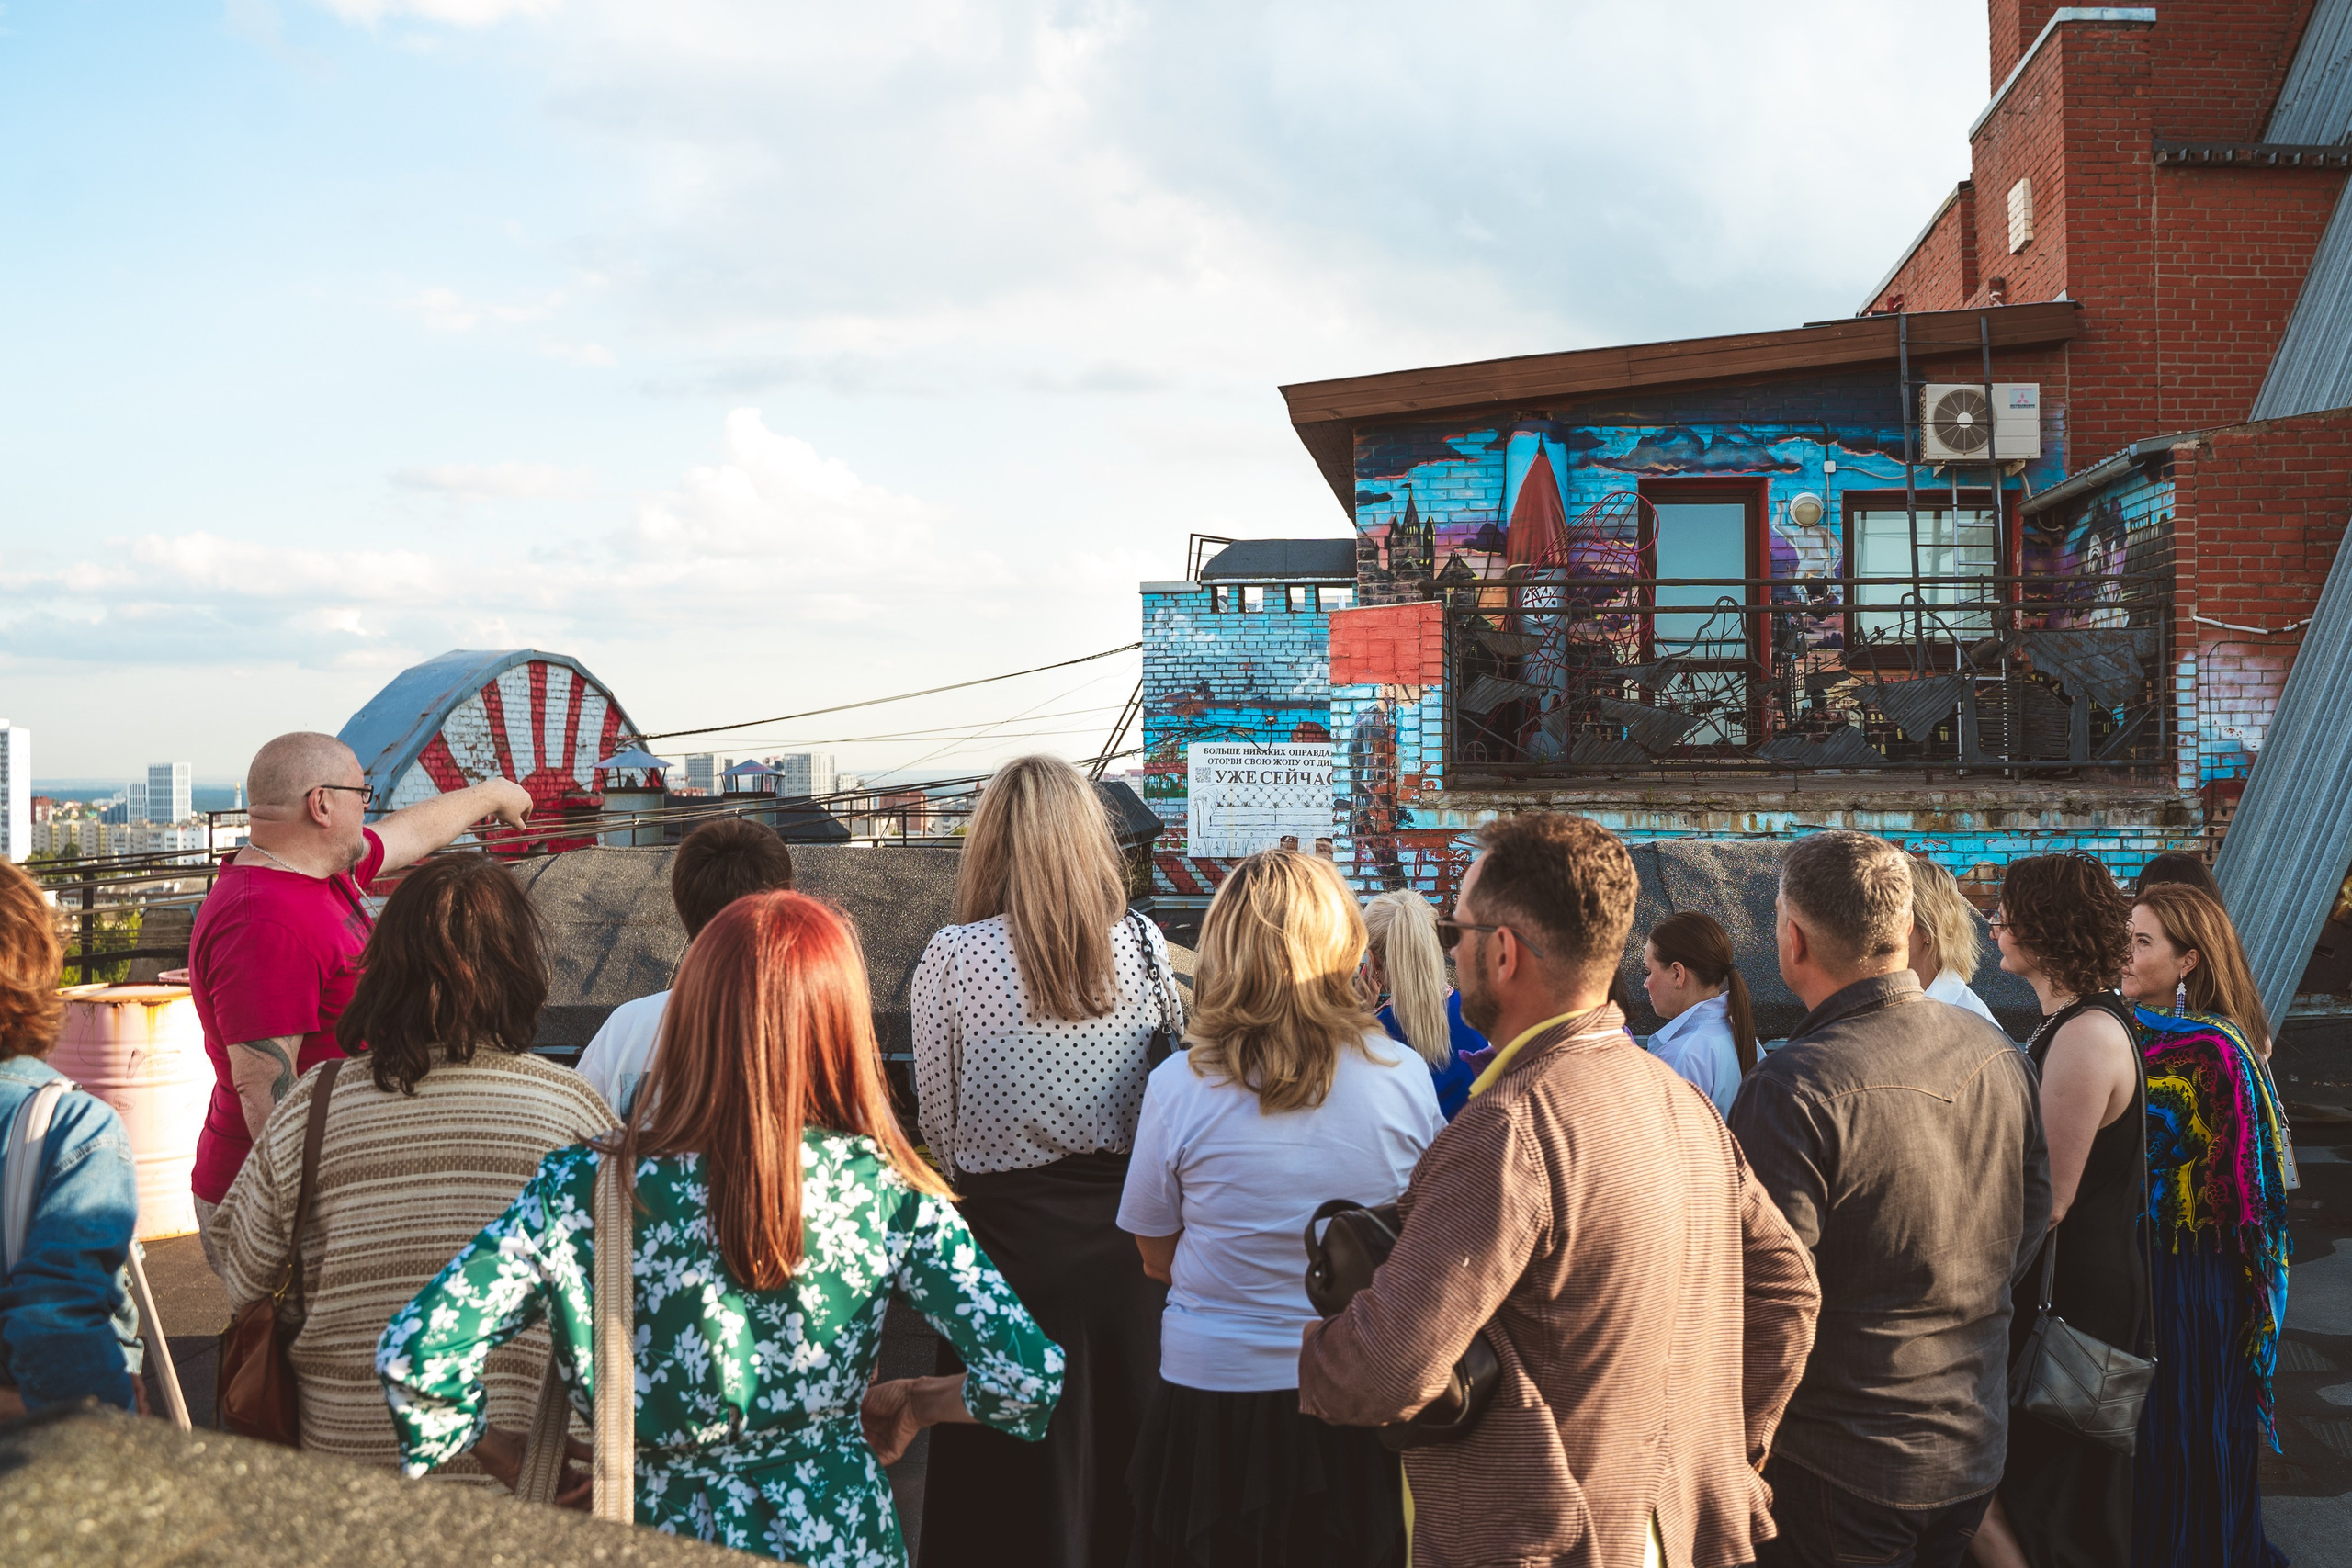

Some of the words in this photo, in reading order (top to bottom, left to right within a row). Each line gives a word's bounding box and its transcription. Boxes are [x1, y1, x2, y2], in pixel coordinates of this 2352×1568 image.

[1243, 748, 1285, 756] НИКАКИХ
[1288, 749, 1332, 757] ОПРАВДА
[1244, 758, 1272, 766] СВОЮ
[1215, 770, 1257, 784] УЖЕ
